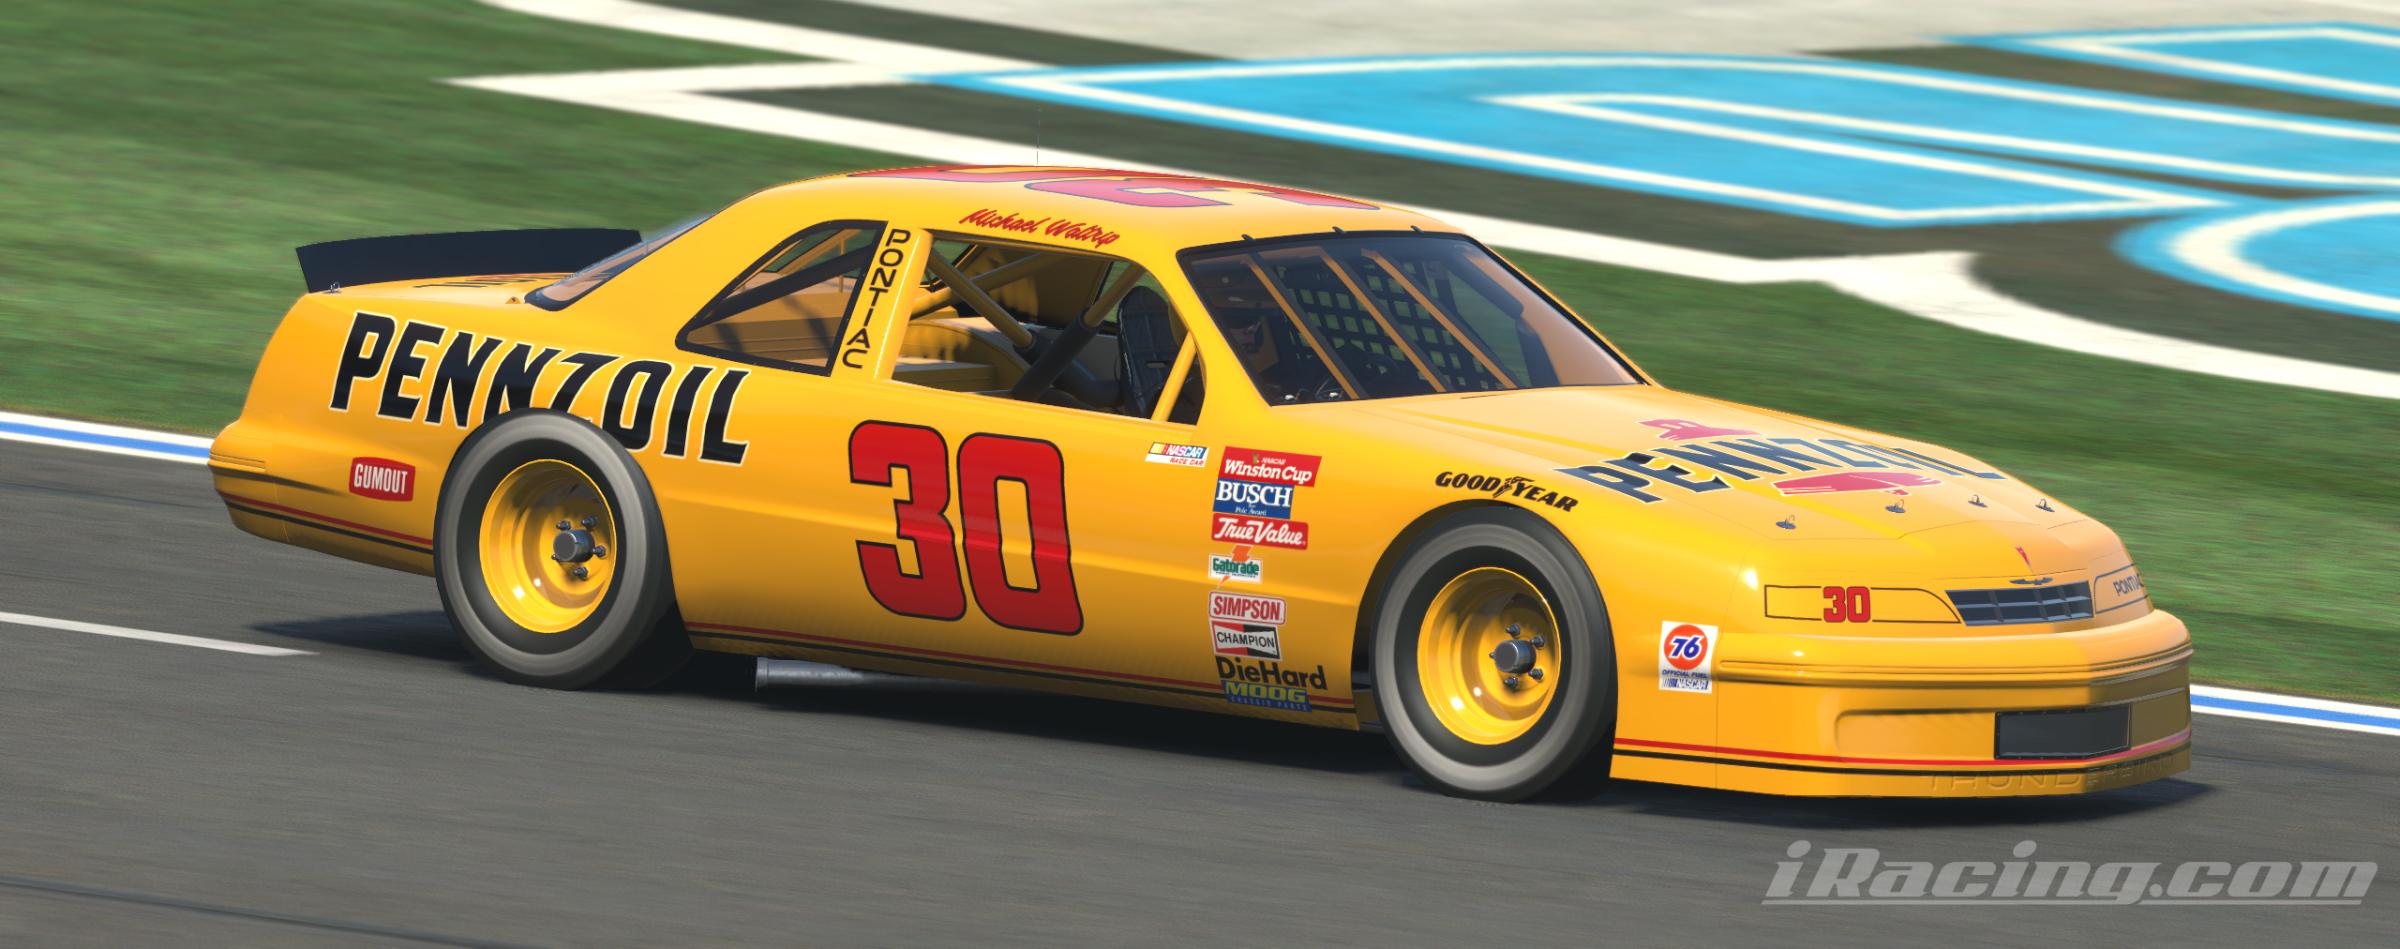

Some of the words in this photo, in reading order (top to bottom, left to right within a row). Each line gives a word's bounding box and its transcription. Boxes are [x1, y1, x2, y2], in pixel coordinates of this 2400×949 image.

[958, 208, 1051, 234] Michael
[1044, 217, 1120, 248] Waltrip
[842, 228, 912, 369] PONTIAC
[329, 312, 751, 468] PENNZOIL
[1166, 445, 1203, 459] NASCAR
[353, 463, 408, 495] GUMOUT
[1223, 459, 1281, 480] Winston
[1281, 466, 1313, 485] Cup
[1552, 437, 2010, 503] PENNZOIL
[1215, 480, 1293, 508] BUSCH
[848, 419, 1084, 636] 30
[1212, 557, 1260, 576] Gatorade
[1213, 596, 1281, 620] SIMPSON
[1823, 586, 1871, 623] 30
[1216, 631, 1275, 649] CHAMPION
[1670, 636, 1703, 658] 76
[1216, 656, 1328, 690] DieHard
[1662, 669, 1689, 677] OFFICIAL
[1226, 681, 1307, 704] MOOG
